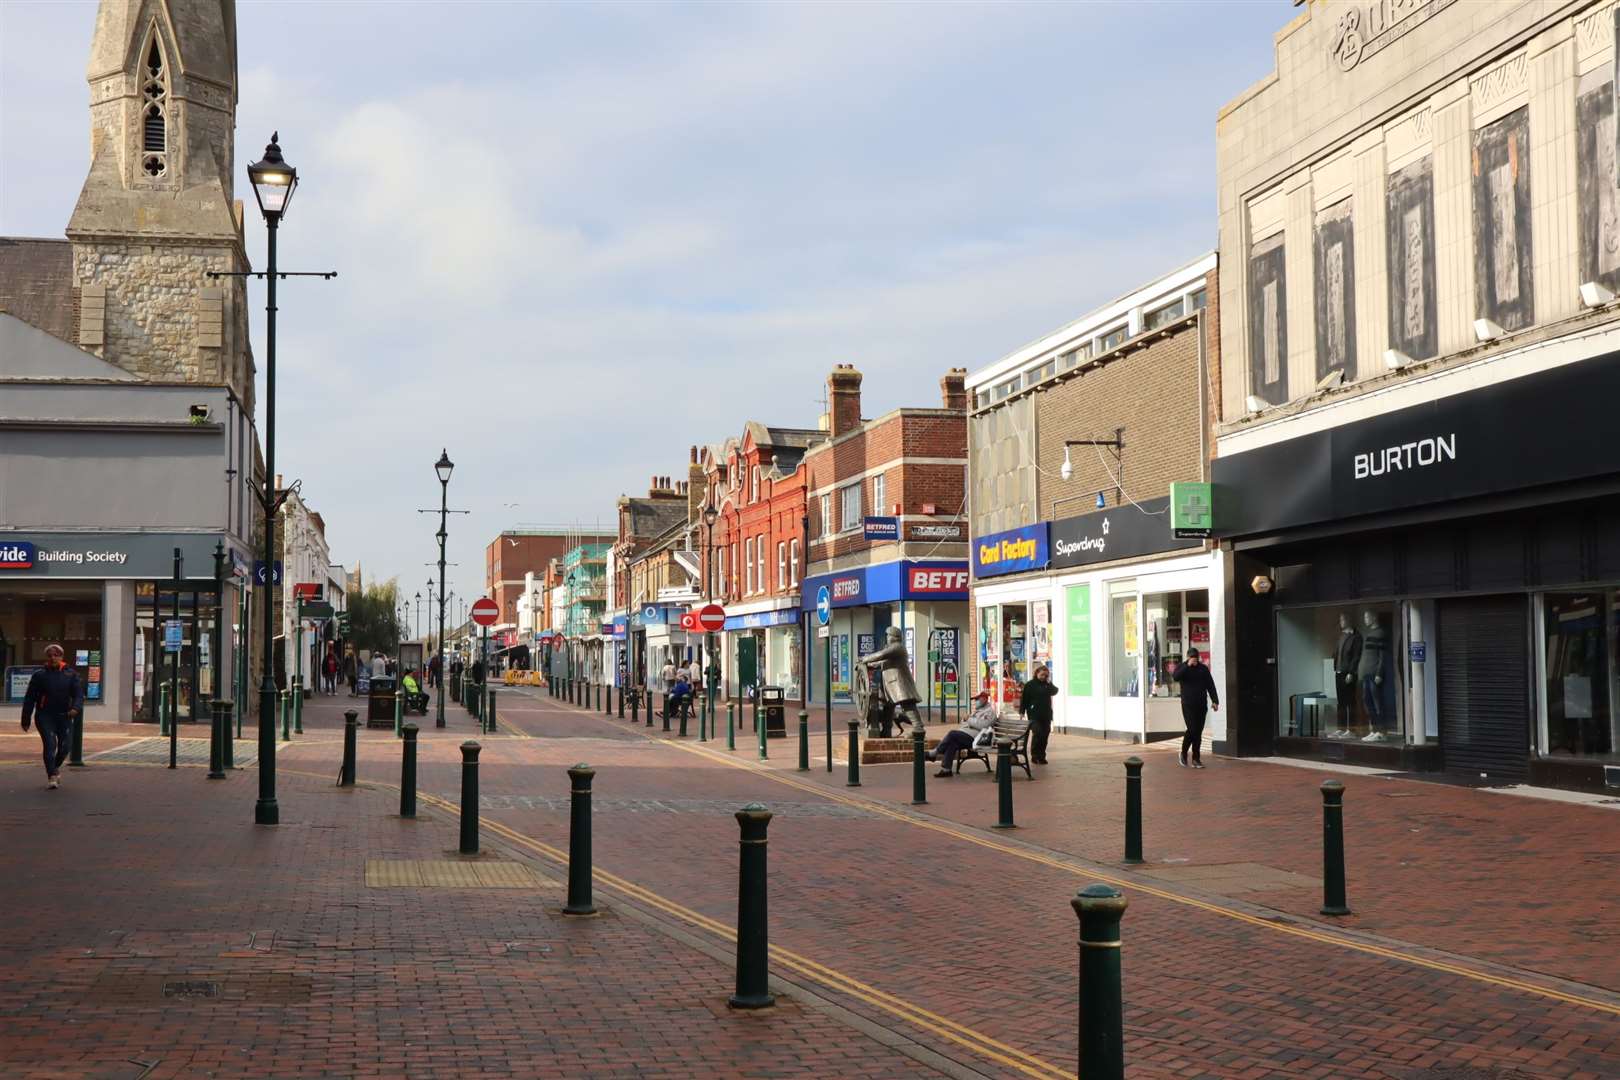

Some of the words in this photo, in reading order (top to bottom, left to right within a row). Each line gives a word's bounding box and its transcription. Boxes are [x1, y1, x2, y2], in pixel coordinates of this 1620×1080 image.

[1354, 433, 1456, 480] BURTON
[980, 542, 999, 565] Card
[1002, 538, 1036, 561] Factory
[1055, 536, 1106, 557] Superdrug
[38, 551, 83, 564] Building
[86, 551, 127, 564] Society
[833, 579, 860, 597] BETFRED
[913, 572, 968, 588] BETF
